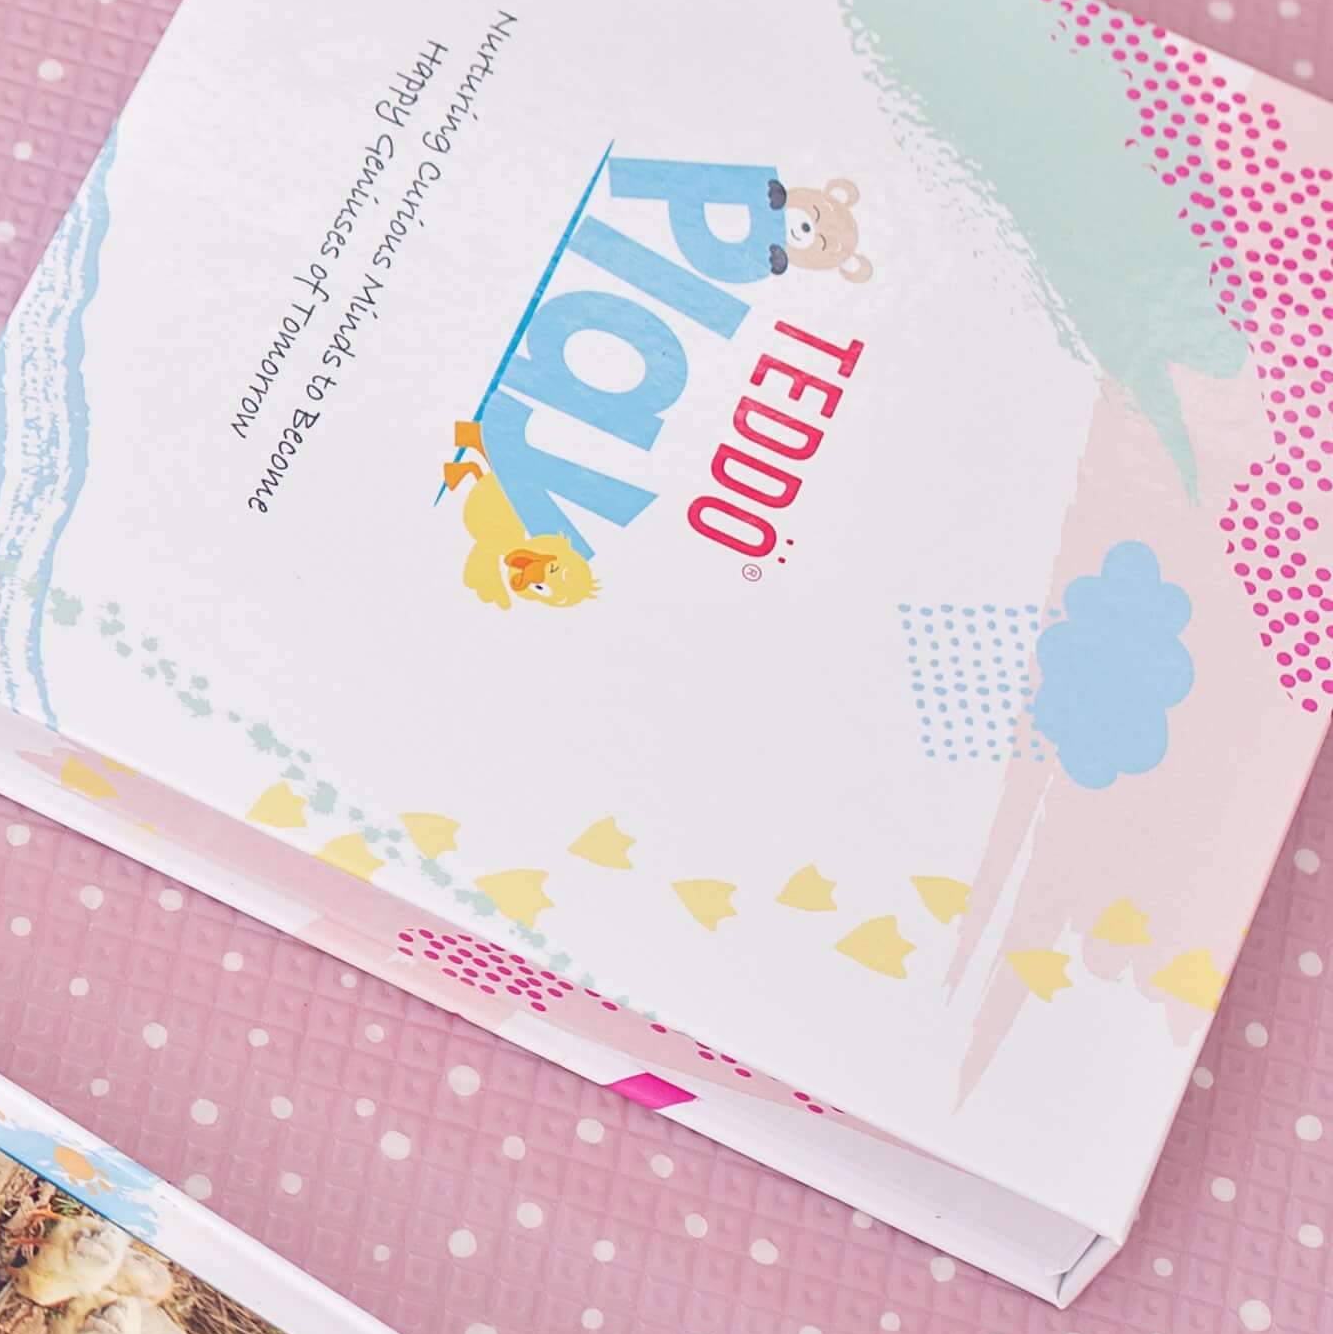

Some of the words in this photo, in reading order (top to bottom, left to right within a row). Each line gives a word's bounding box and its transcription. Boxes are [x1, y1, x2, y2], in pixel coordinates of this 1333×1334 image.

[375, 40, 449, 127] Happy
[423, 9, 517, 154] Nurturing
[320, 134, 394, 259] Geniuses
[373, 161, 441, 268] Curious
[293, 264, 329, 302] of
[323, 273, 383, 368] Minds
[230, 303, 316, 438] Tomorrow
[306, 374, 337, 401] to
[479, 156, 787, 561] Play
[248, 408, 320, 513] Become
